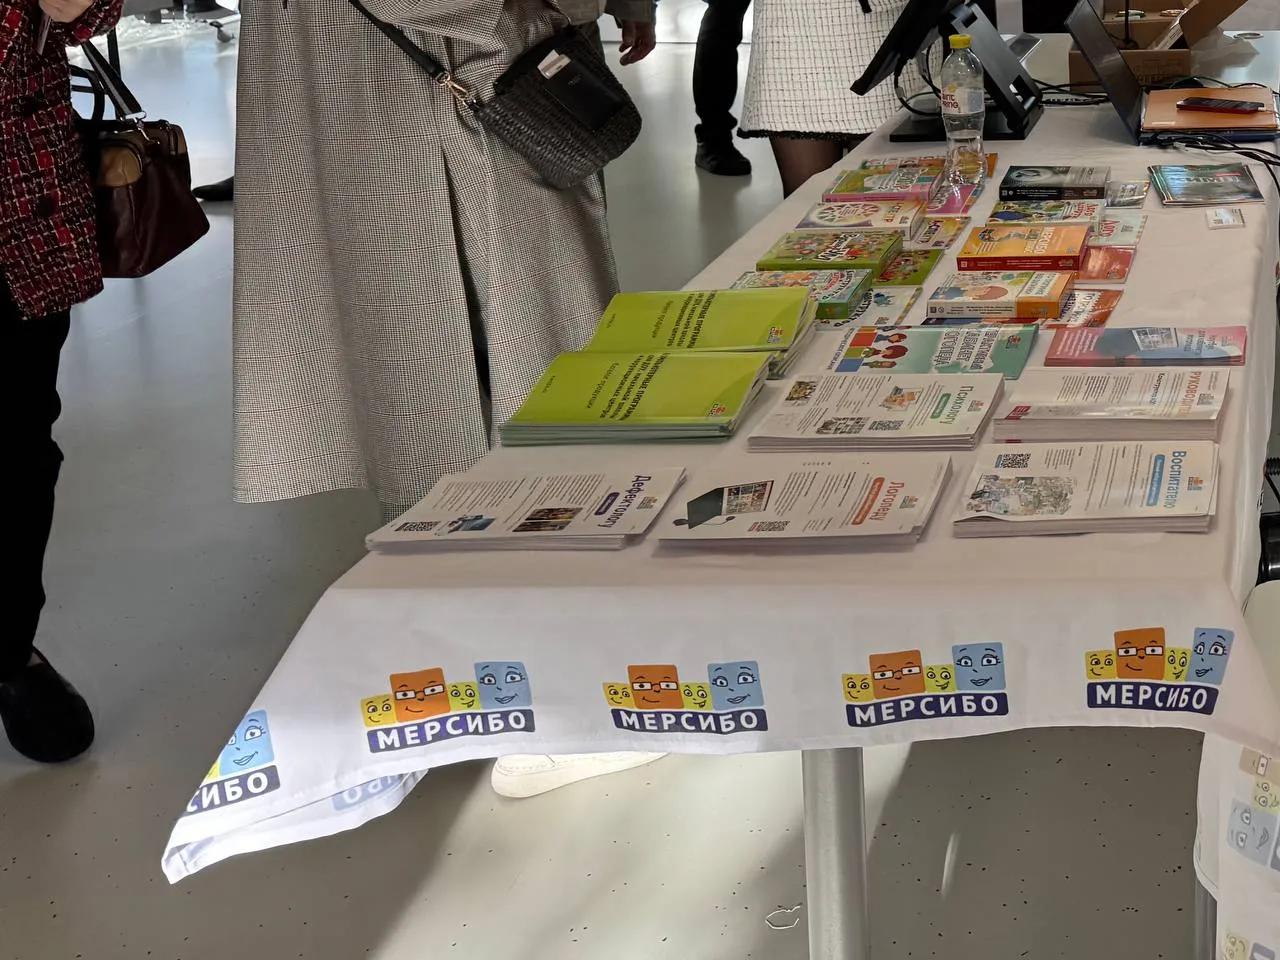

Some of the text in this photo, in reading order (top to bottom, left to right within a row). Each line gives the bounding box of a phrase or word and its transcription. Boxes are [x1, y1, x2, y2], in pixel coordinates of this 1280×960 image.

[939, 385, 974, 425] Психологу
[1163, 450, 1188, 510] Воспитателю
[596, 474, 651, 529] Дефектологу
[868, 481, 905, 523] Логопеду
[855, 694, 999, 725] МЕРСИБО
[1095, 684, 1208, 710] МЕРСИБО
[377, 711, 527, 751] МЕРСИБО
[621, 709, 758, 734] МЕРСИБО
